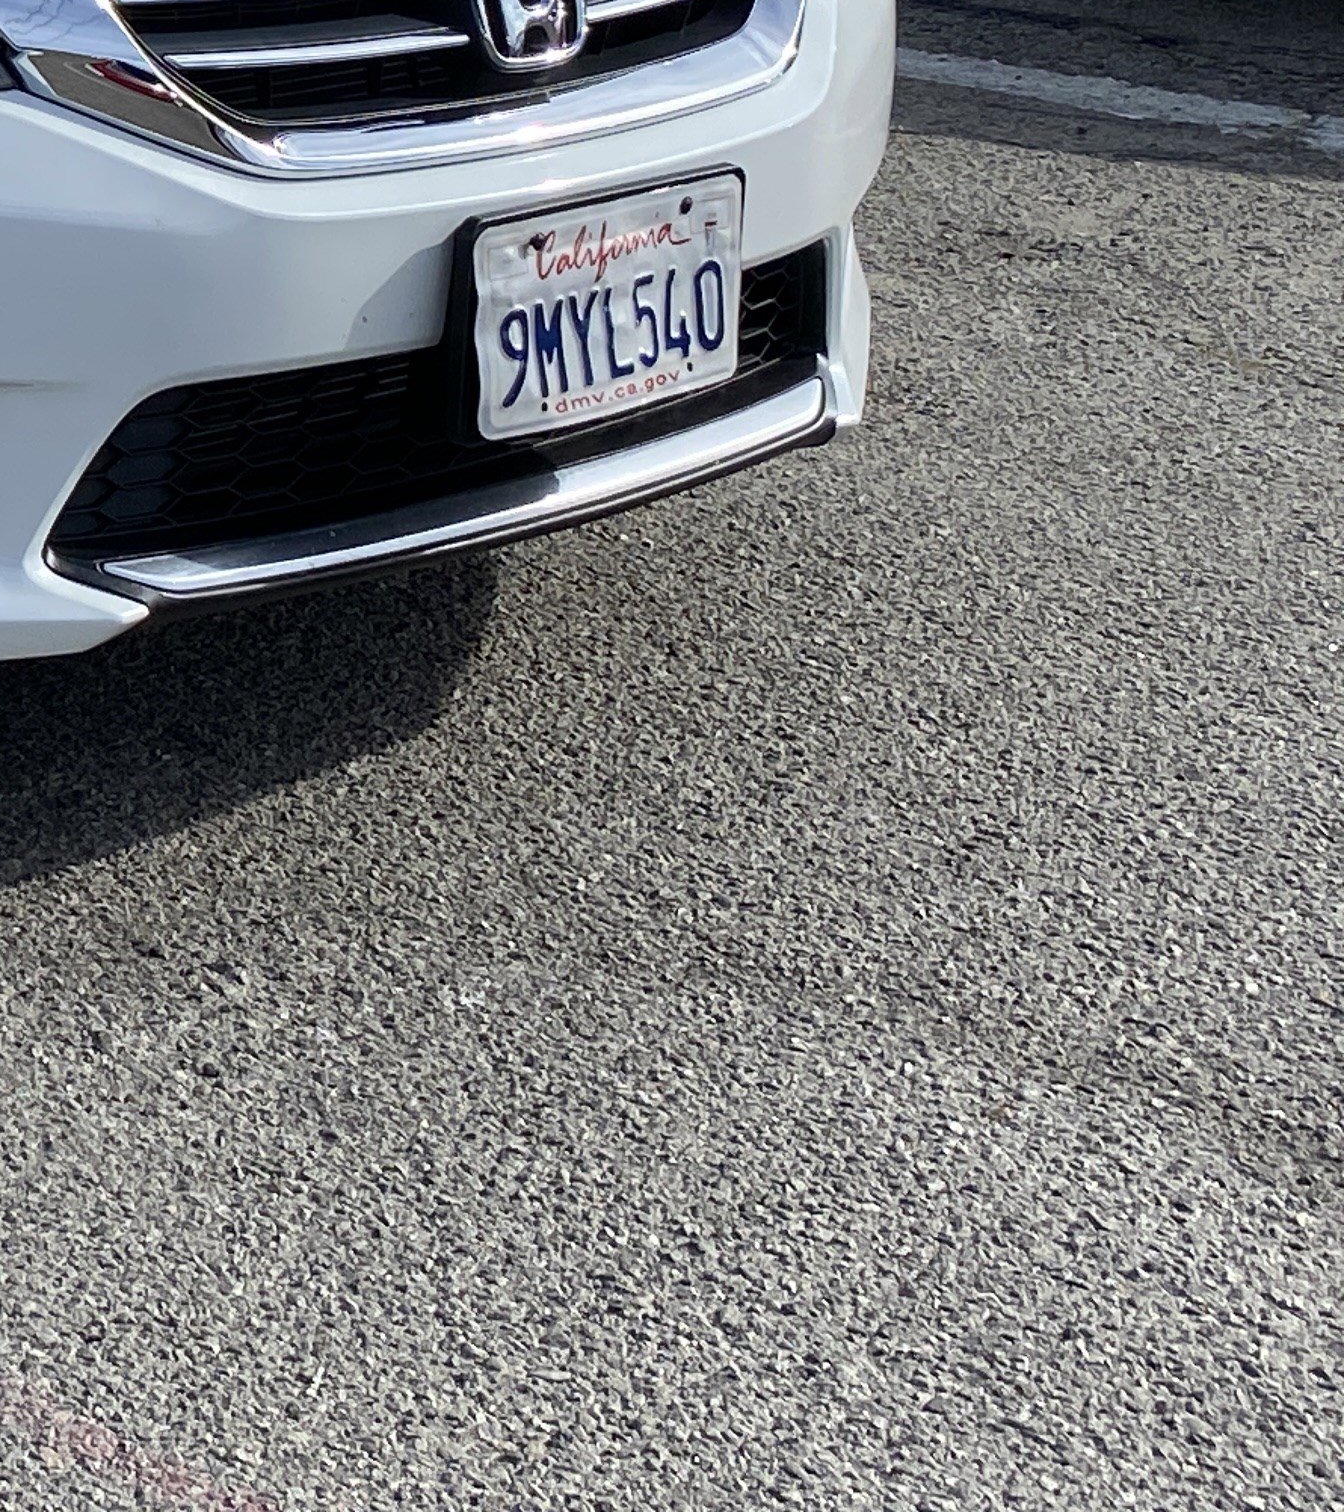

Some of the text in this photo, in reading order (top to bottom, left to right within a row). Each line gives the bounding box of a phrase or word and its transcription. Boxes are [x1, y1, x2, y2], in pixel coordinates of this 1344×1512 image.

[534, 220, 692, 281] California
[499, 259, 725, 408] 9MYL540
[555, 369, 680, 414] dmv.ca.gov
